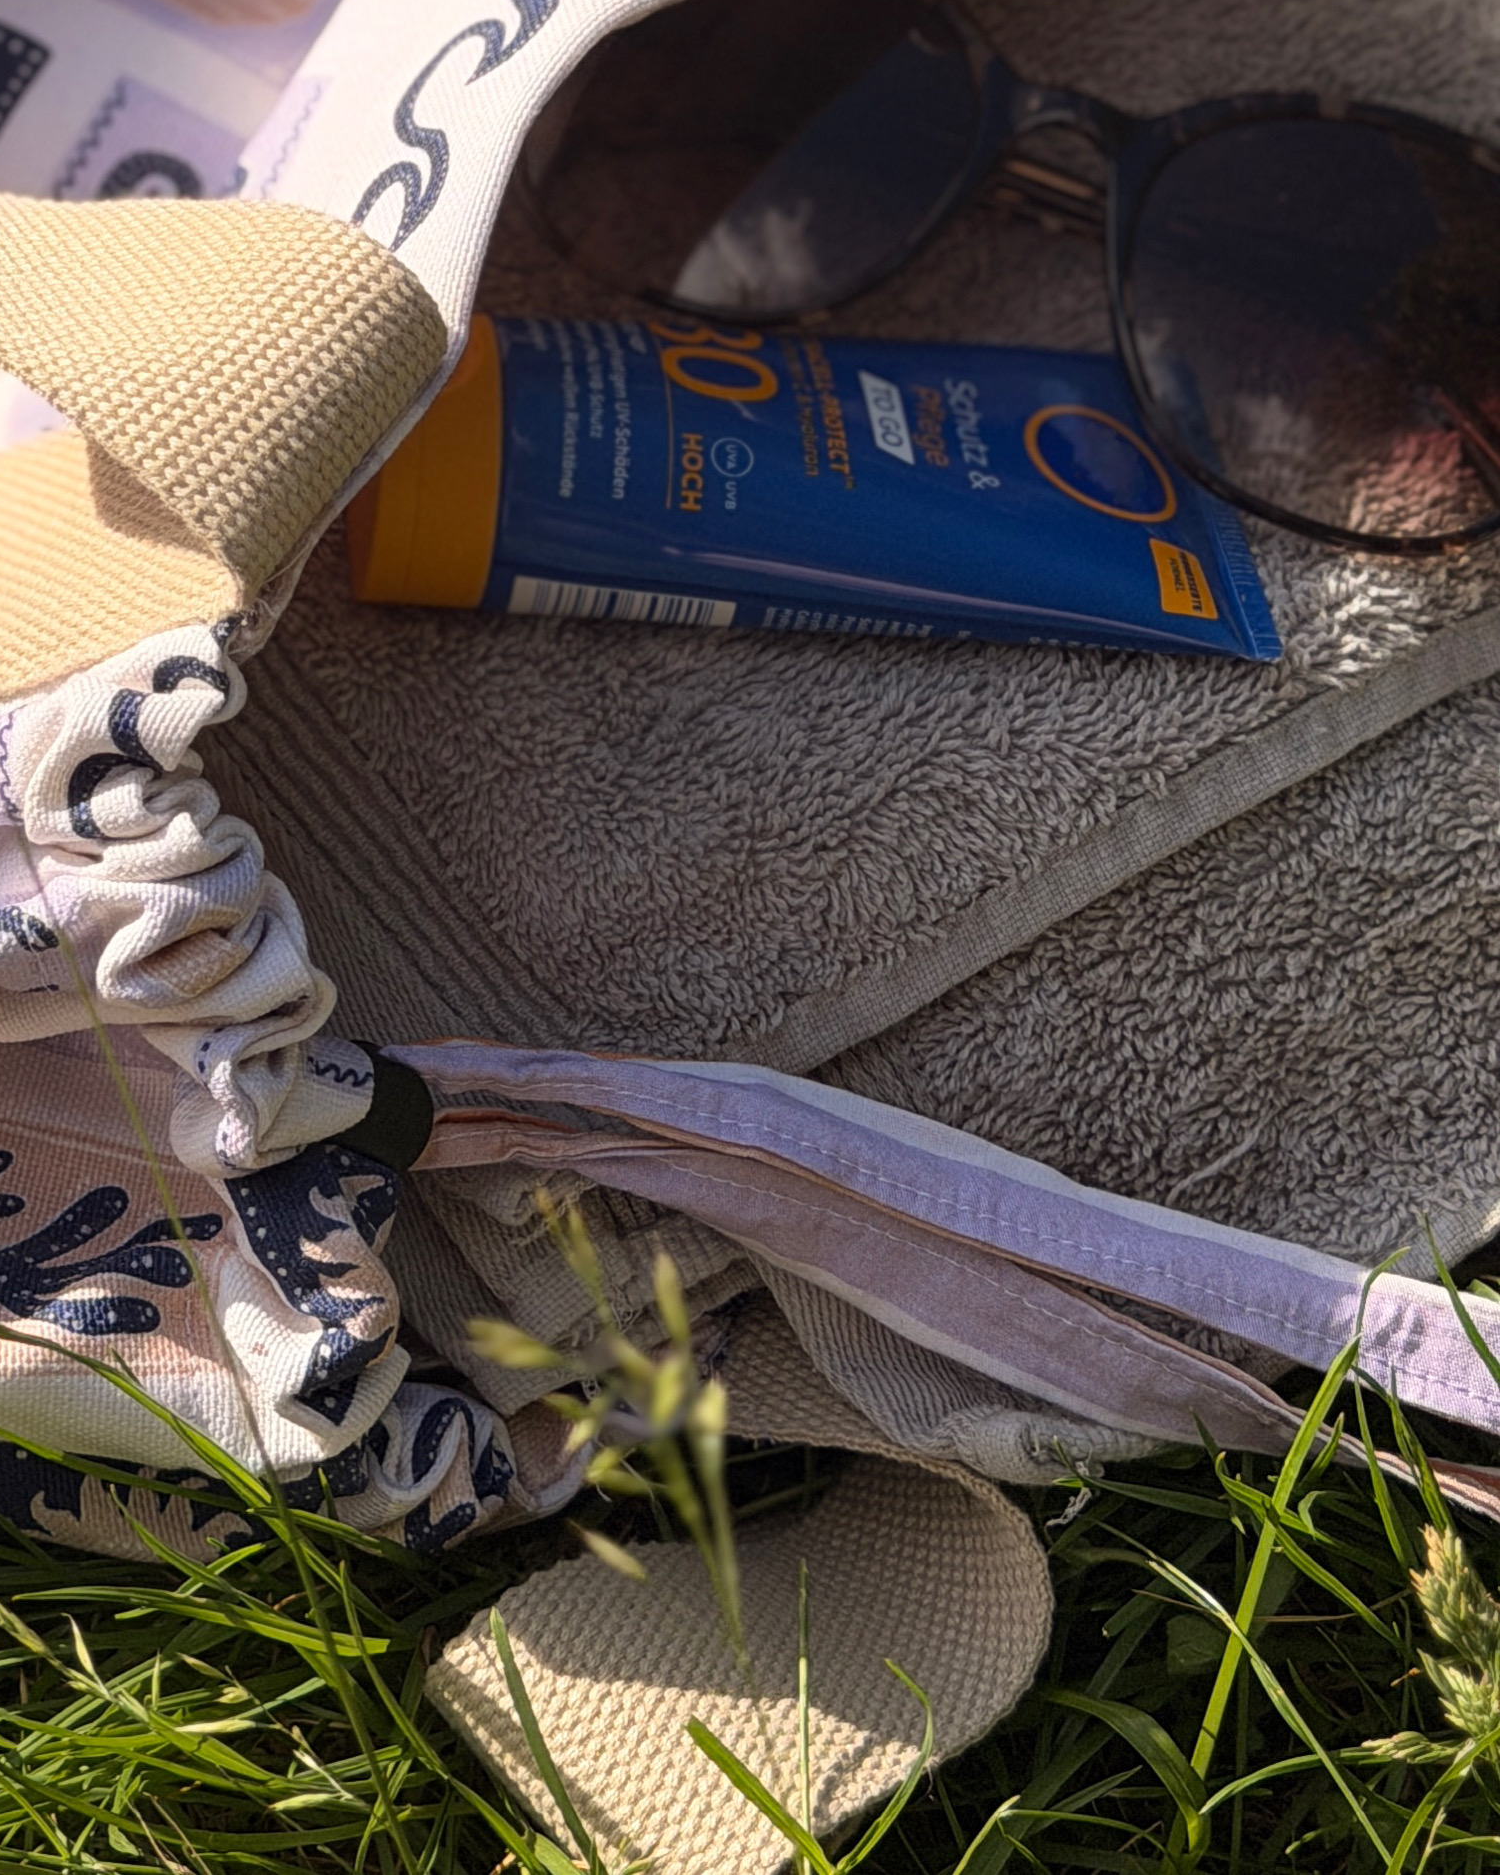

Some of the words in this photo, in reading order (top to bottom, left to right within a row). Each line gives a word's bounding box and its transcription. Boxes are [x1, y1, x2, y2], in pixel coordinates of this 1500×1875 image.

[871, 387, 895, 412] TO
[878, 417, 904, 447] GO
[908, 383, 952, 468] Pflege
[943, 377, 990, 468] Schutz
[968, 470, 1001, 490] &
[559, 410, 581, 499] Rückstände
[611, 401, 632, 500] UV-Schäden
[679, 432, 704, 512] HOCH
[725, 443, 739, 470] UVA
[724, 480, 737, 511] UVB
